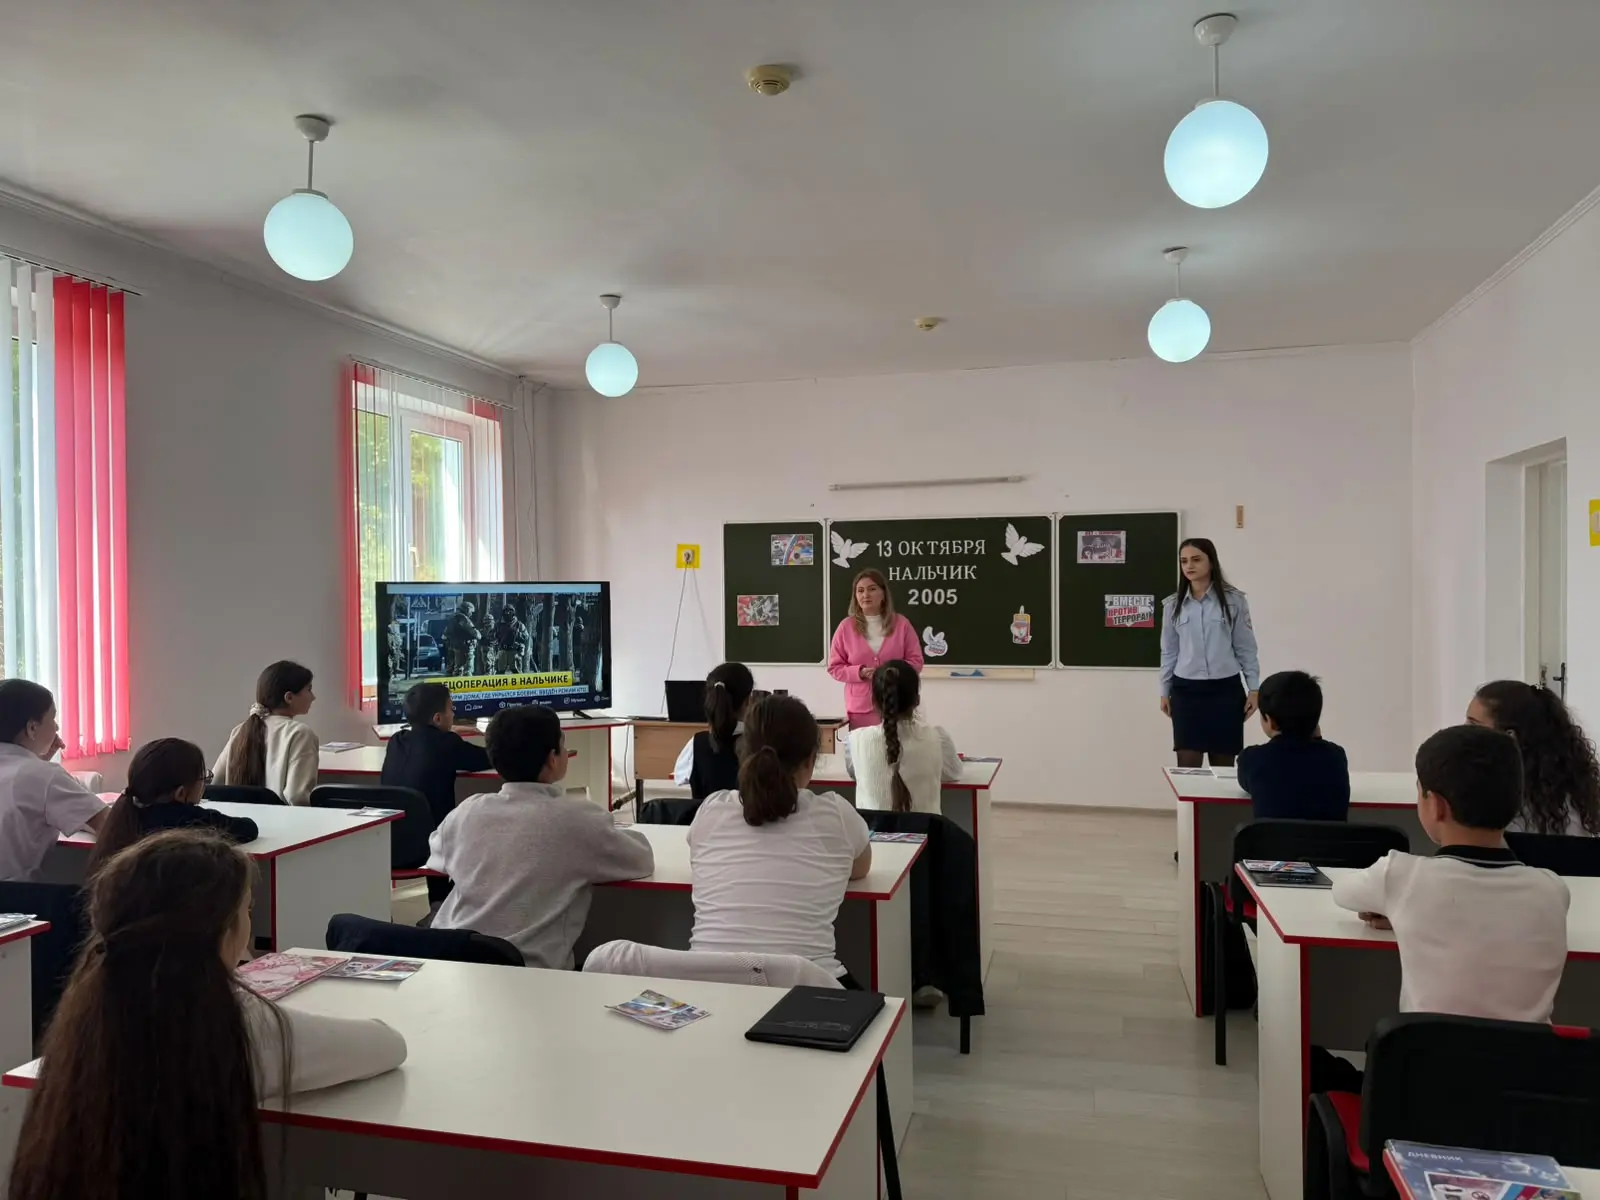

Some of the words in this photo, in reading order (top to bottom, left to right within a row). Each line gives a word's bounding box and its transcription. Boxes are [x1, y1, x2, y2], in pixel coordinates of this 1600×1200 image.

[876, 540, 893, 557] 13
[898, 539, 986, 556] ОКТЯБРЯ
[888, 565, 977, 581] НАЛЬЧИК
[907, 588, 958, 605] 2005
[1112, 596, 1151, 606] ВМЕСТЕ
[1109, 606, 1137, 616] ПРОТИВ
[443, 678, 508, 690] ЕЦОПЕРАЦИЯ
[511, 677, 517, 686] В
[519, 674, 569, 685] НАЛЬЧИКЕ
